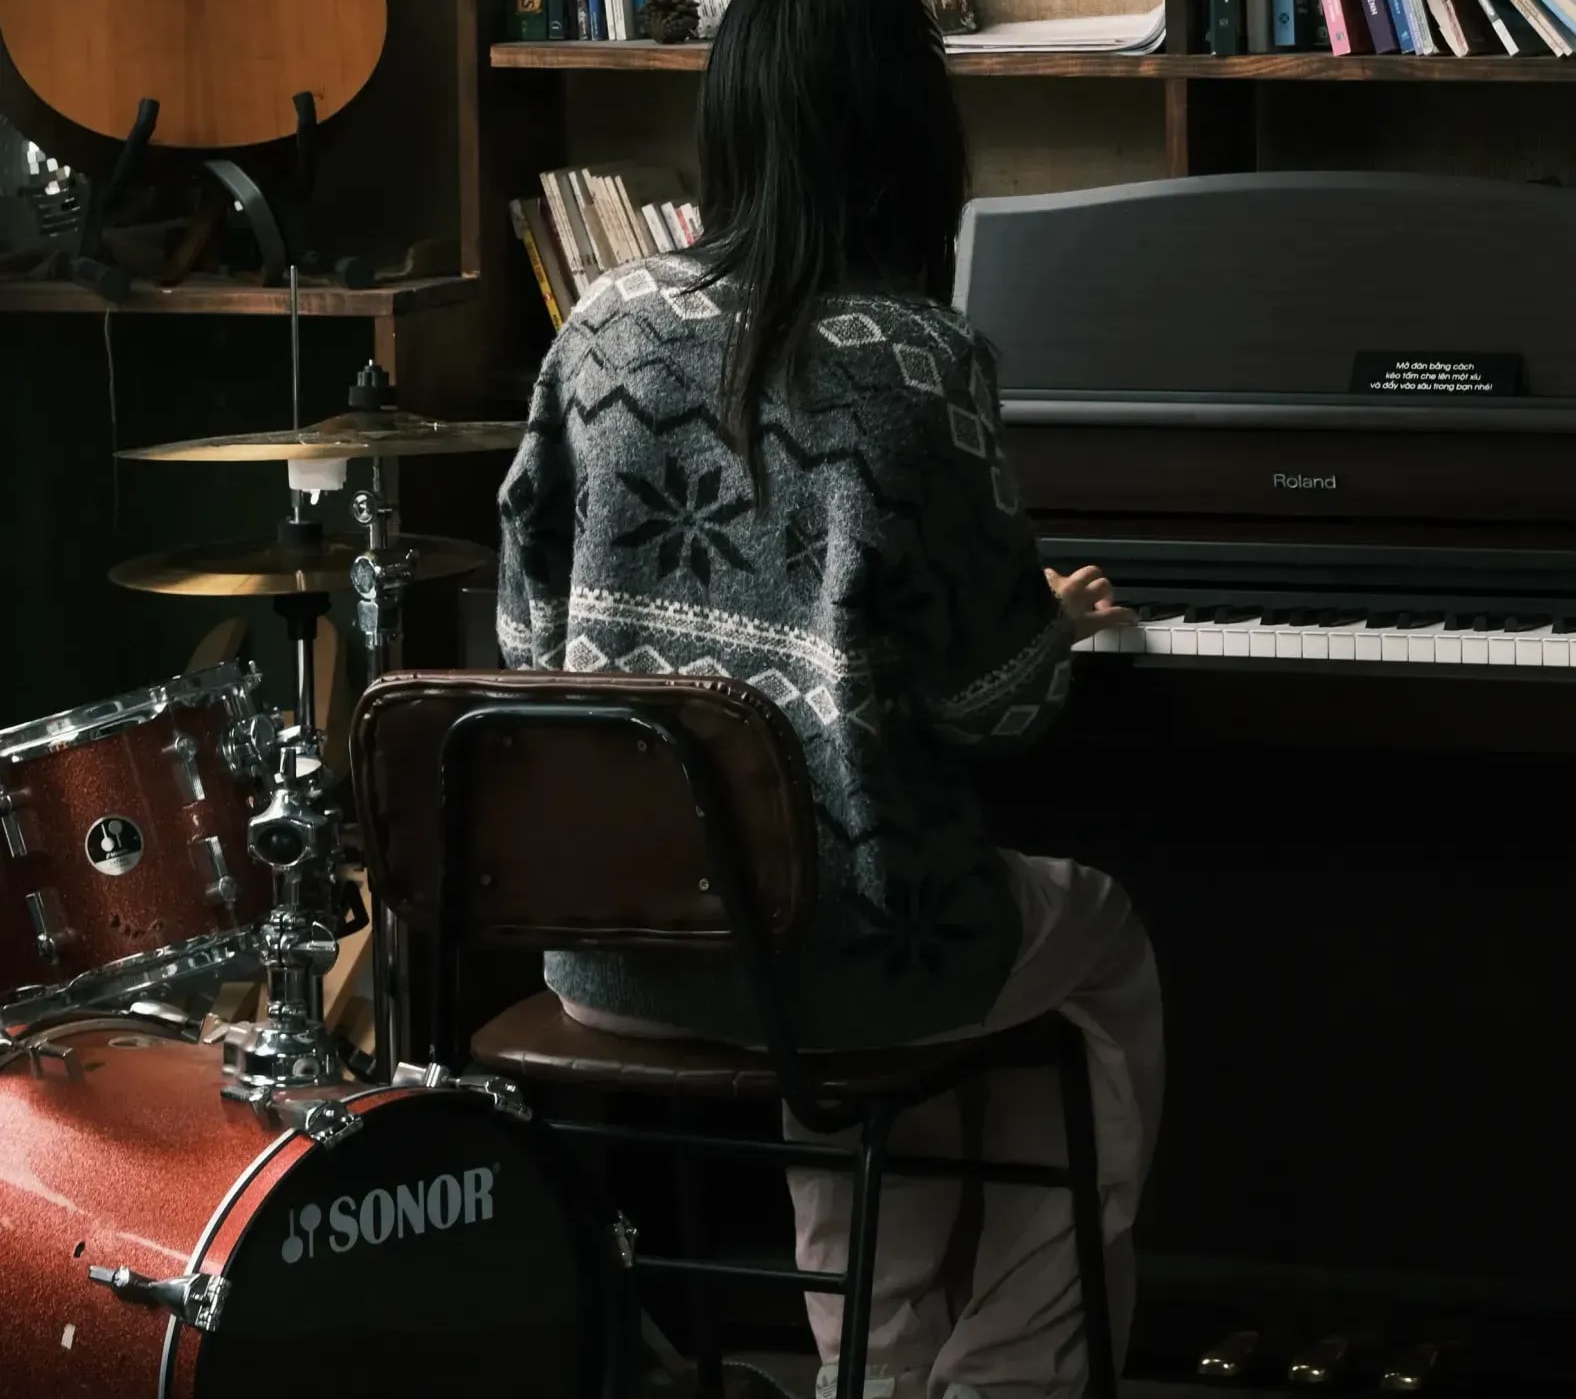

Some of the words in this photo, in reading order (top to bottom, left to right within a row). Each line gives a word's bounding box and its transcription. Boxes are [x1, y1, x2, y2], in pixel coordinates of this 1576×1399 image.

[1453, 362, 1474, 370] cách
[1421, 372, 1436, 380] che
[1434, 383, 1454, 391] trong
[1273, 473, 1337, 490] Roland
[328, 1165, 495, 1254] SONOR
